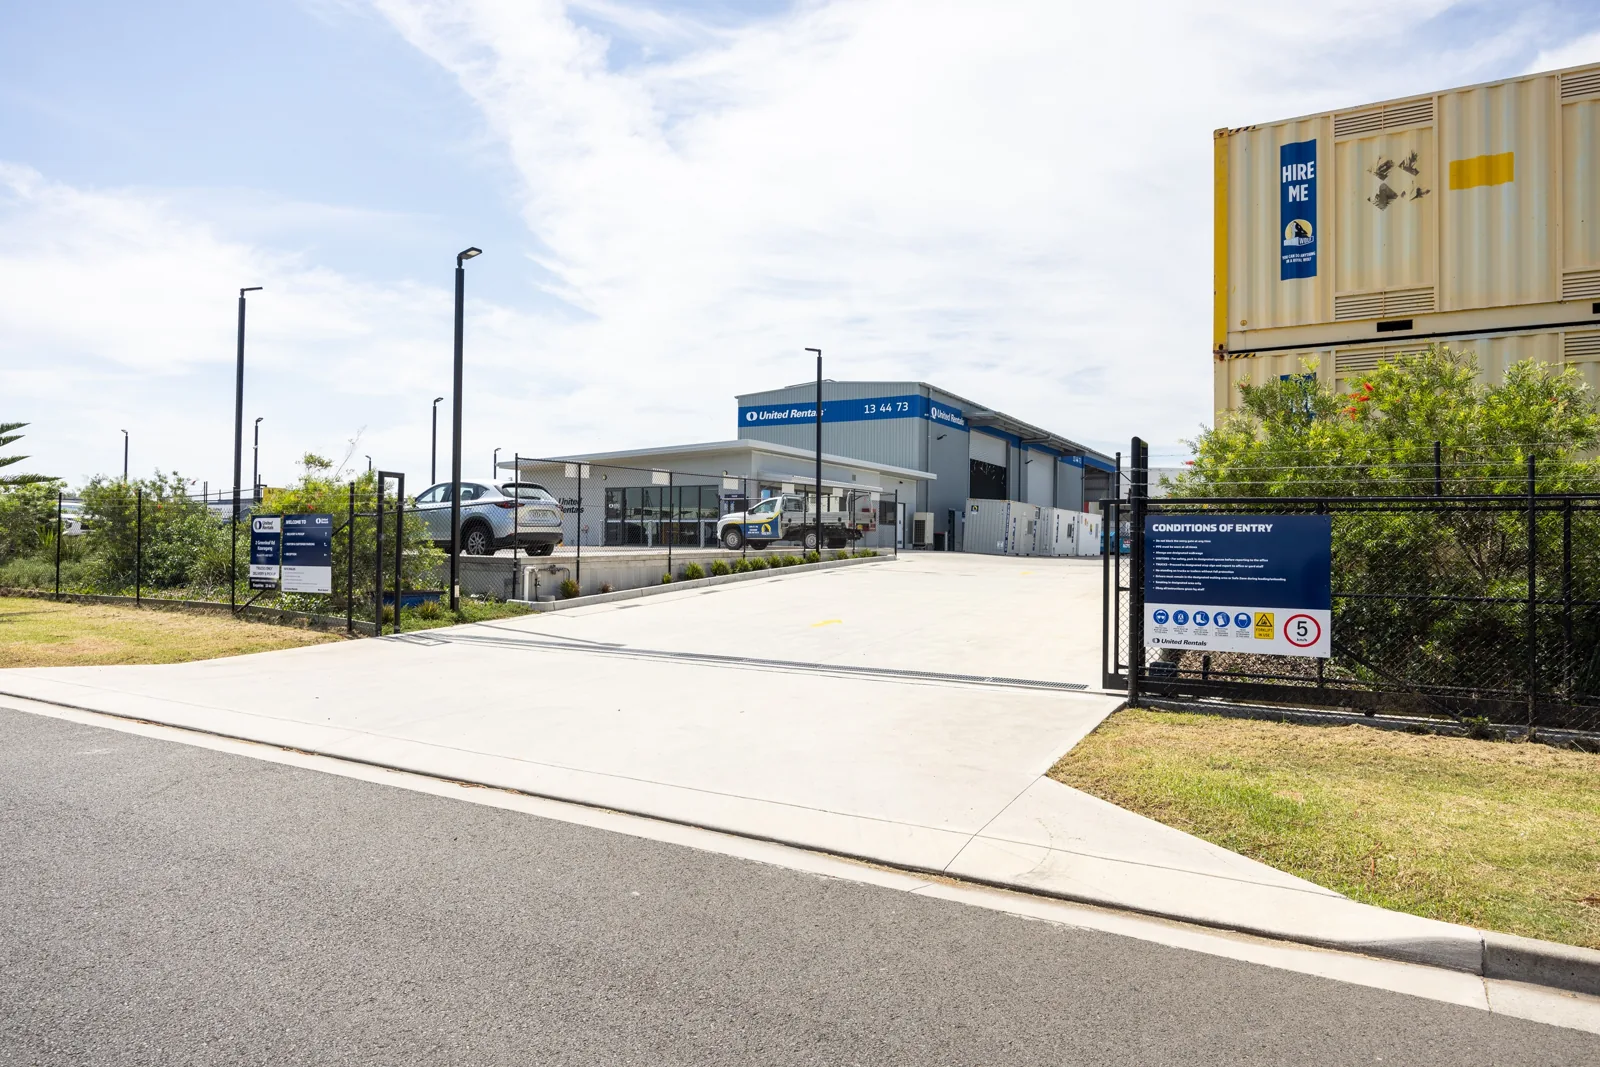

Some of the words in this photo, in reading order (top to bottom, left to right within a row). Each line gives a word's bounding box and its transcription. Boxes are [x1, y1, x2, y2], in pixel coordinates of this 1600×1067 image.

[1282, 161, 1314, 183] HIRE
[1288, 184, 1308, 202] ME
[759, 410, 789, 420] United
[864, 404, 876, 414] 13
[880, 403, 892, 412] 44
[896, 402, 908, 412] 73
[938, 409, 950, 421] United
[951, 413, 964, 426] Rentals
[1152, 523, 1217, 532] CONDITIONS
[1219, 524, 1233, 532] OF
[1235, 524, 1273, 533] ENTRY
[1296, 621, 1308, 637] 5
